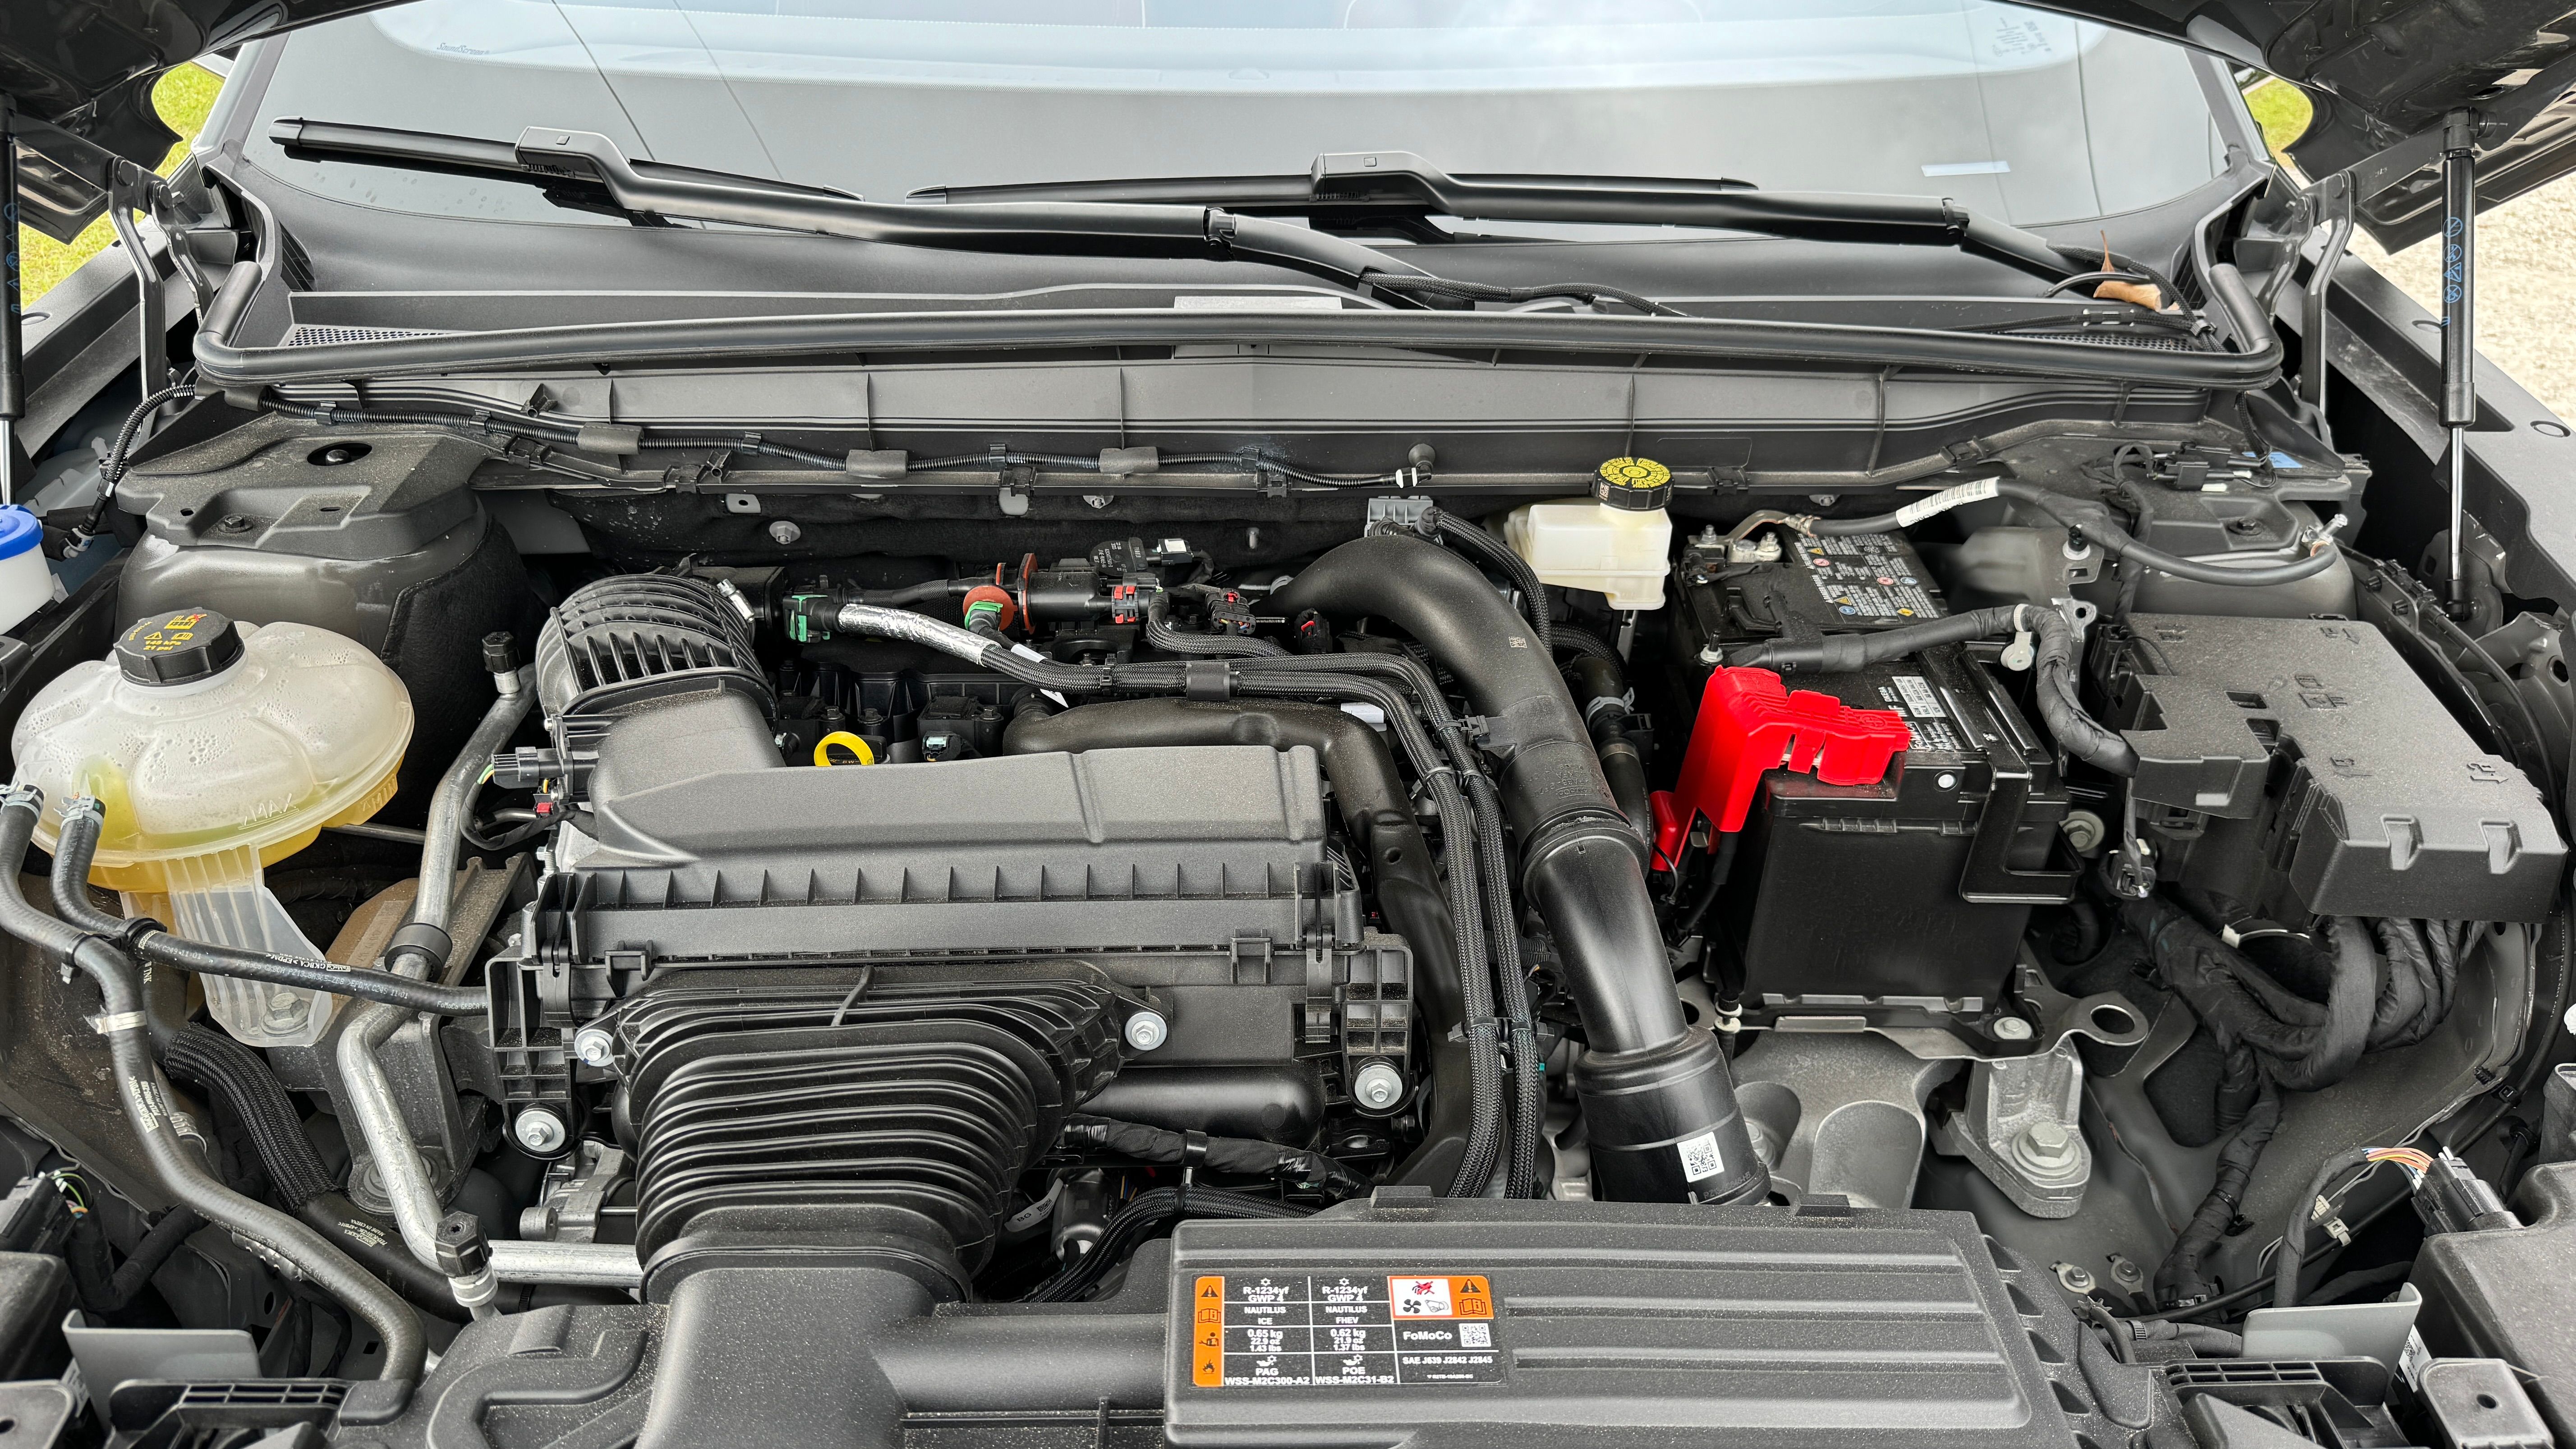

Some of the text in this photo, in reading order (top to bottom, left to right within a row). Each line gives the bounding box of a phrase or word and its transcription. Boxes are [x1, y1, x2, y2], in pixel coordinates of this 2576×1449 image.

[372, 778, 397, 812] MIN
[252, 793, 296, 822] MAX
[236, 960, 262, 971] FoMoCo
[301, 960, 326, 969] GKBCA
[437, 1000, 459, 1010] FoMoCo
[1243, 1286, 1289, 1295] R-1234yf
[1322, 1286, 1368, 1295] R-1234yf
[1247, 1329, 1283, 1339] 0.65 kg
[1330, 1328, 1366, 1339] 0.62 kg
[1403, 1330, 1453, 1340] FoMoCo
[1402, 1356, 1493, 1364] SAE J639 J2842 J2845
[1255, 1367, 1279, 1376] PAG
[1342, 1366, 1366, 1375] POE
[1224, 1376, 1311, 1385] WSS-M2C300-A2
[1315, 1375, 1395, 1384] WSS-M2C31-B2
